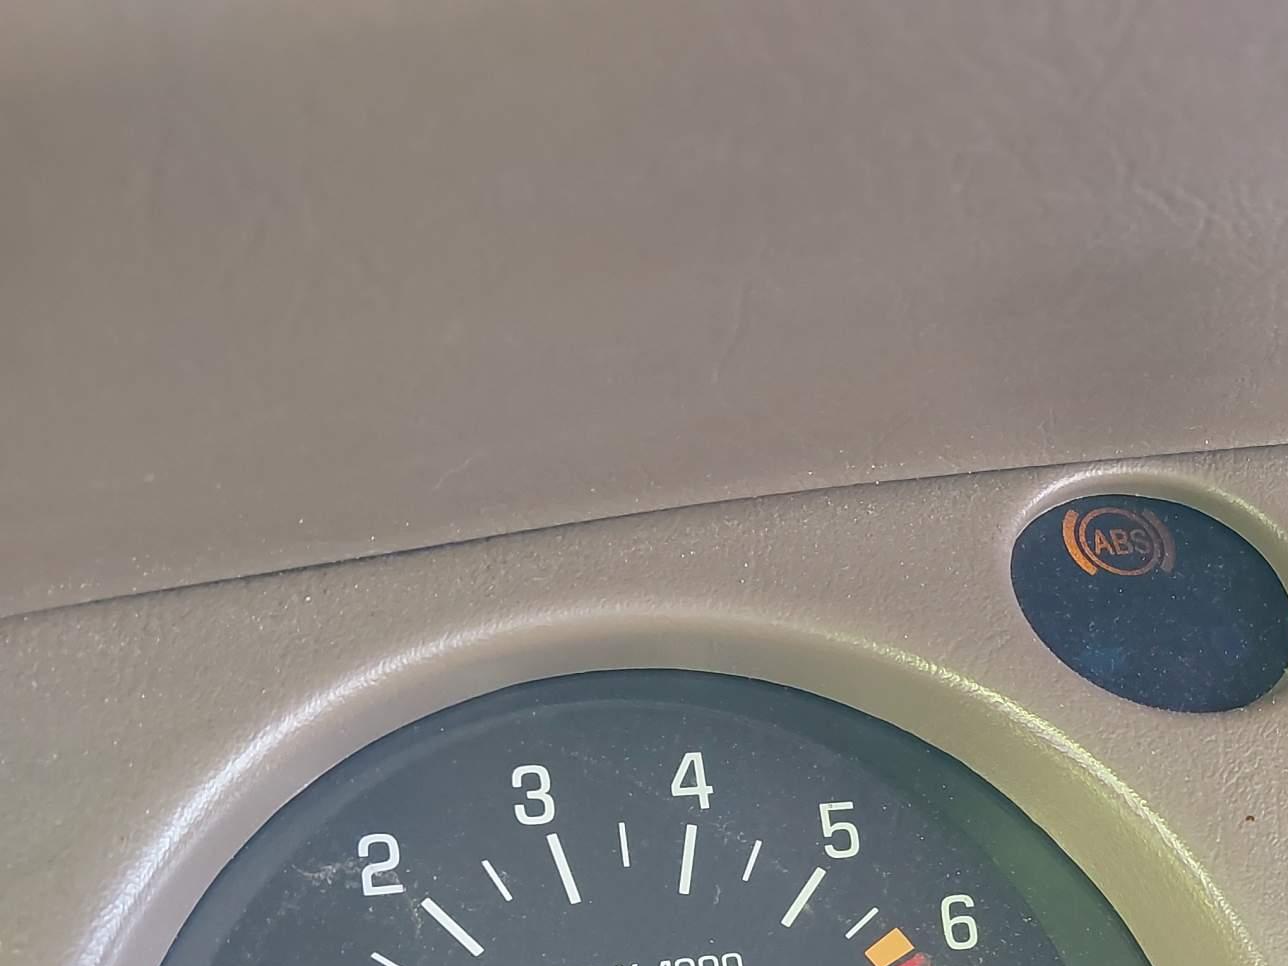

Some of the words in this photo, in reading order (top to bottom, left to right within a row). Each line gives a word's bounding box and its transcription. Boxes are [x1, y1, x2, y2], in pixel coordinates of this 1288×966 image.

[1094, 528, 1150, 554] ABS
[511, 765, 557, 826] 3
[671, 751, 714, 809] 4
[819, 801, 860, 859] 5
[357, 832, 405, 897] 2
[940, 894, 978, 951] 6
